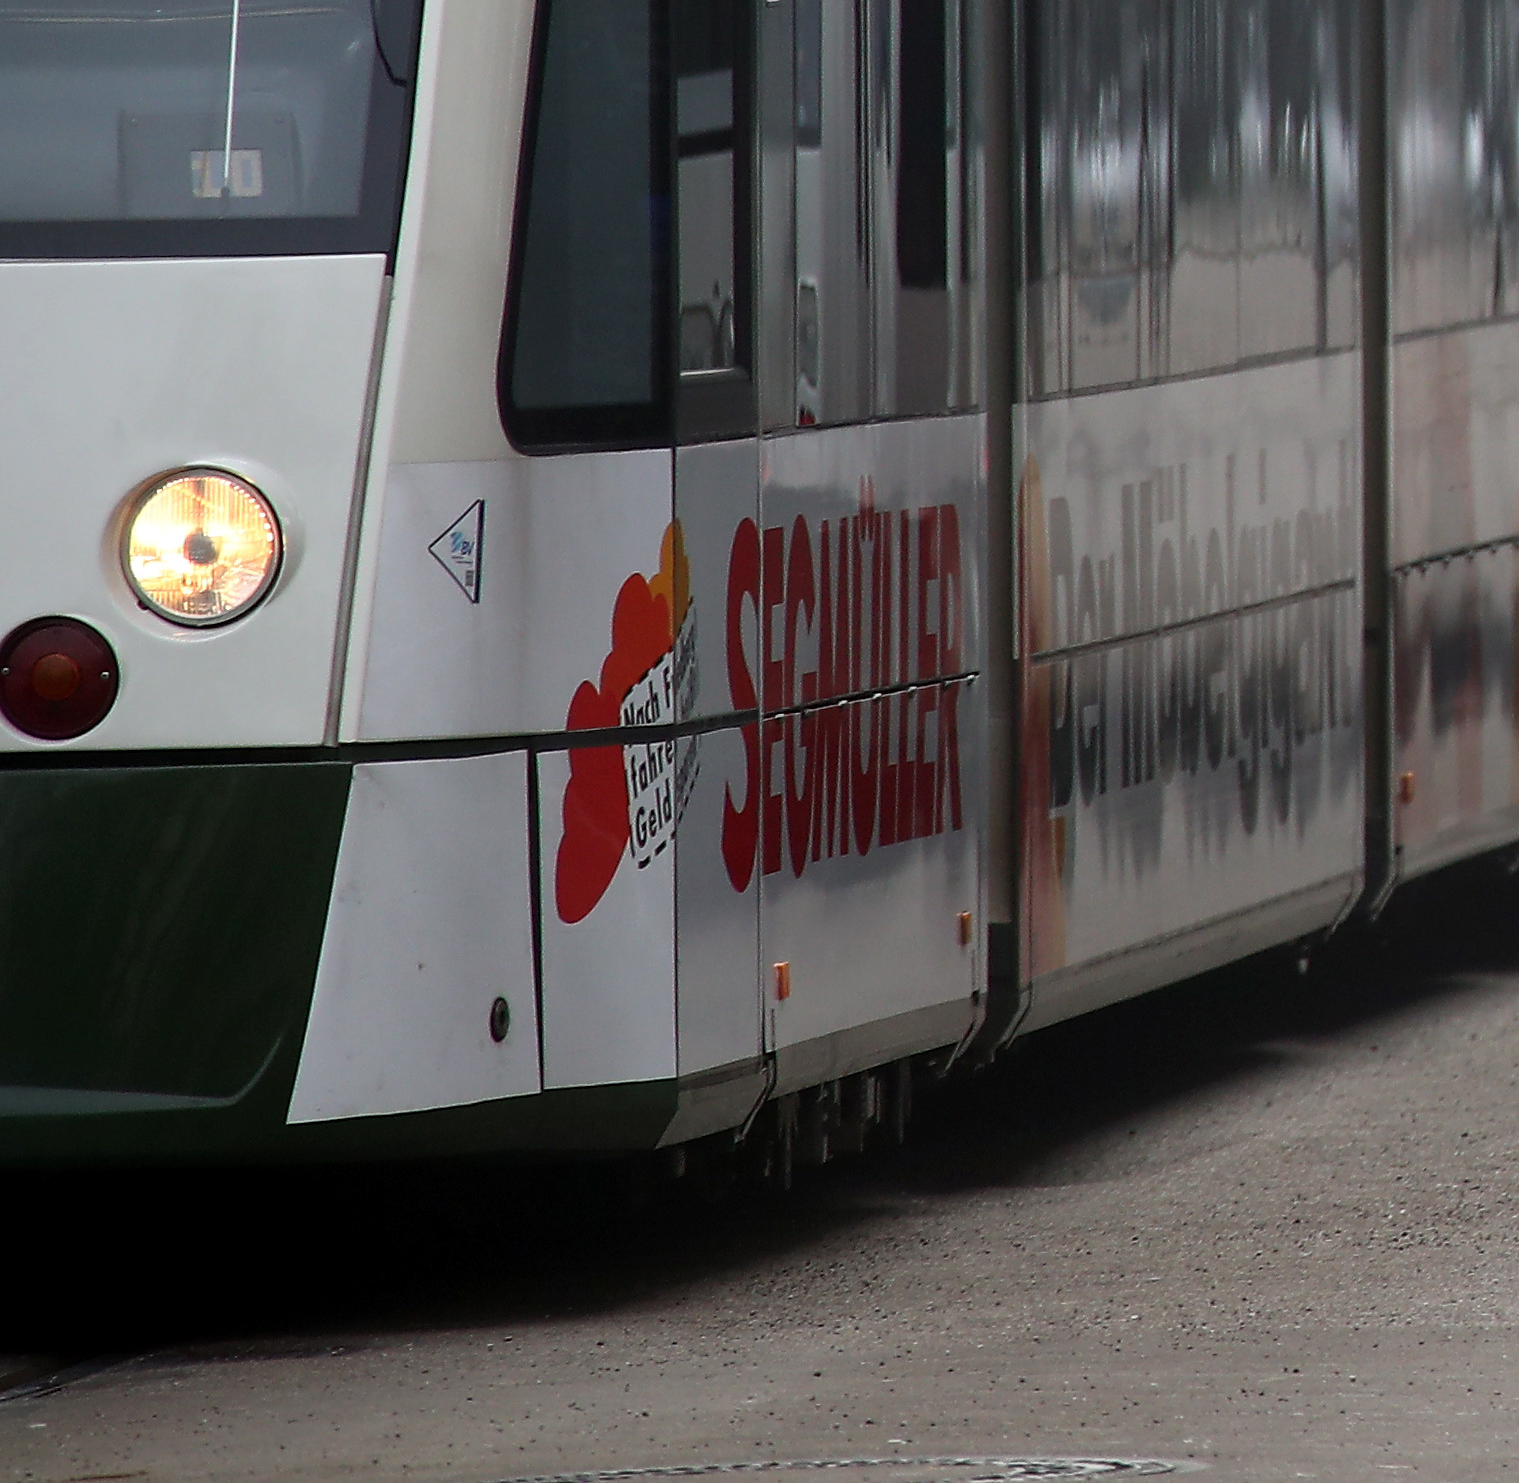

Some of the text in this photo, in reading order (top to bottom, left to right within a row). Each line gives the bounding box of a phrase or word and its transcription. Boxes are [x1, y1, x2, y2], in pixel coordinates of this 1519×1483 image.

[721, 474, 962, 893] SEGMÜLLER
[1049, 496, 1116, 809] Der
[635, 777, 674, 849] Geld
